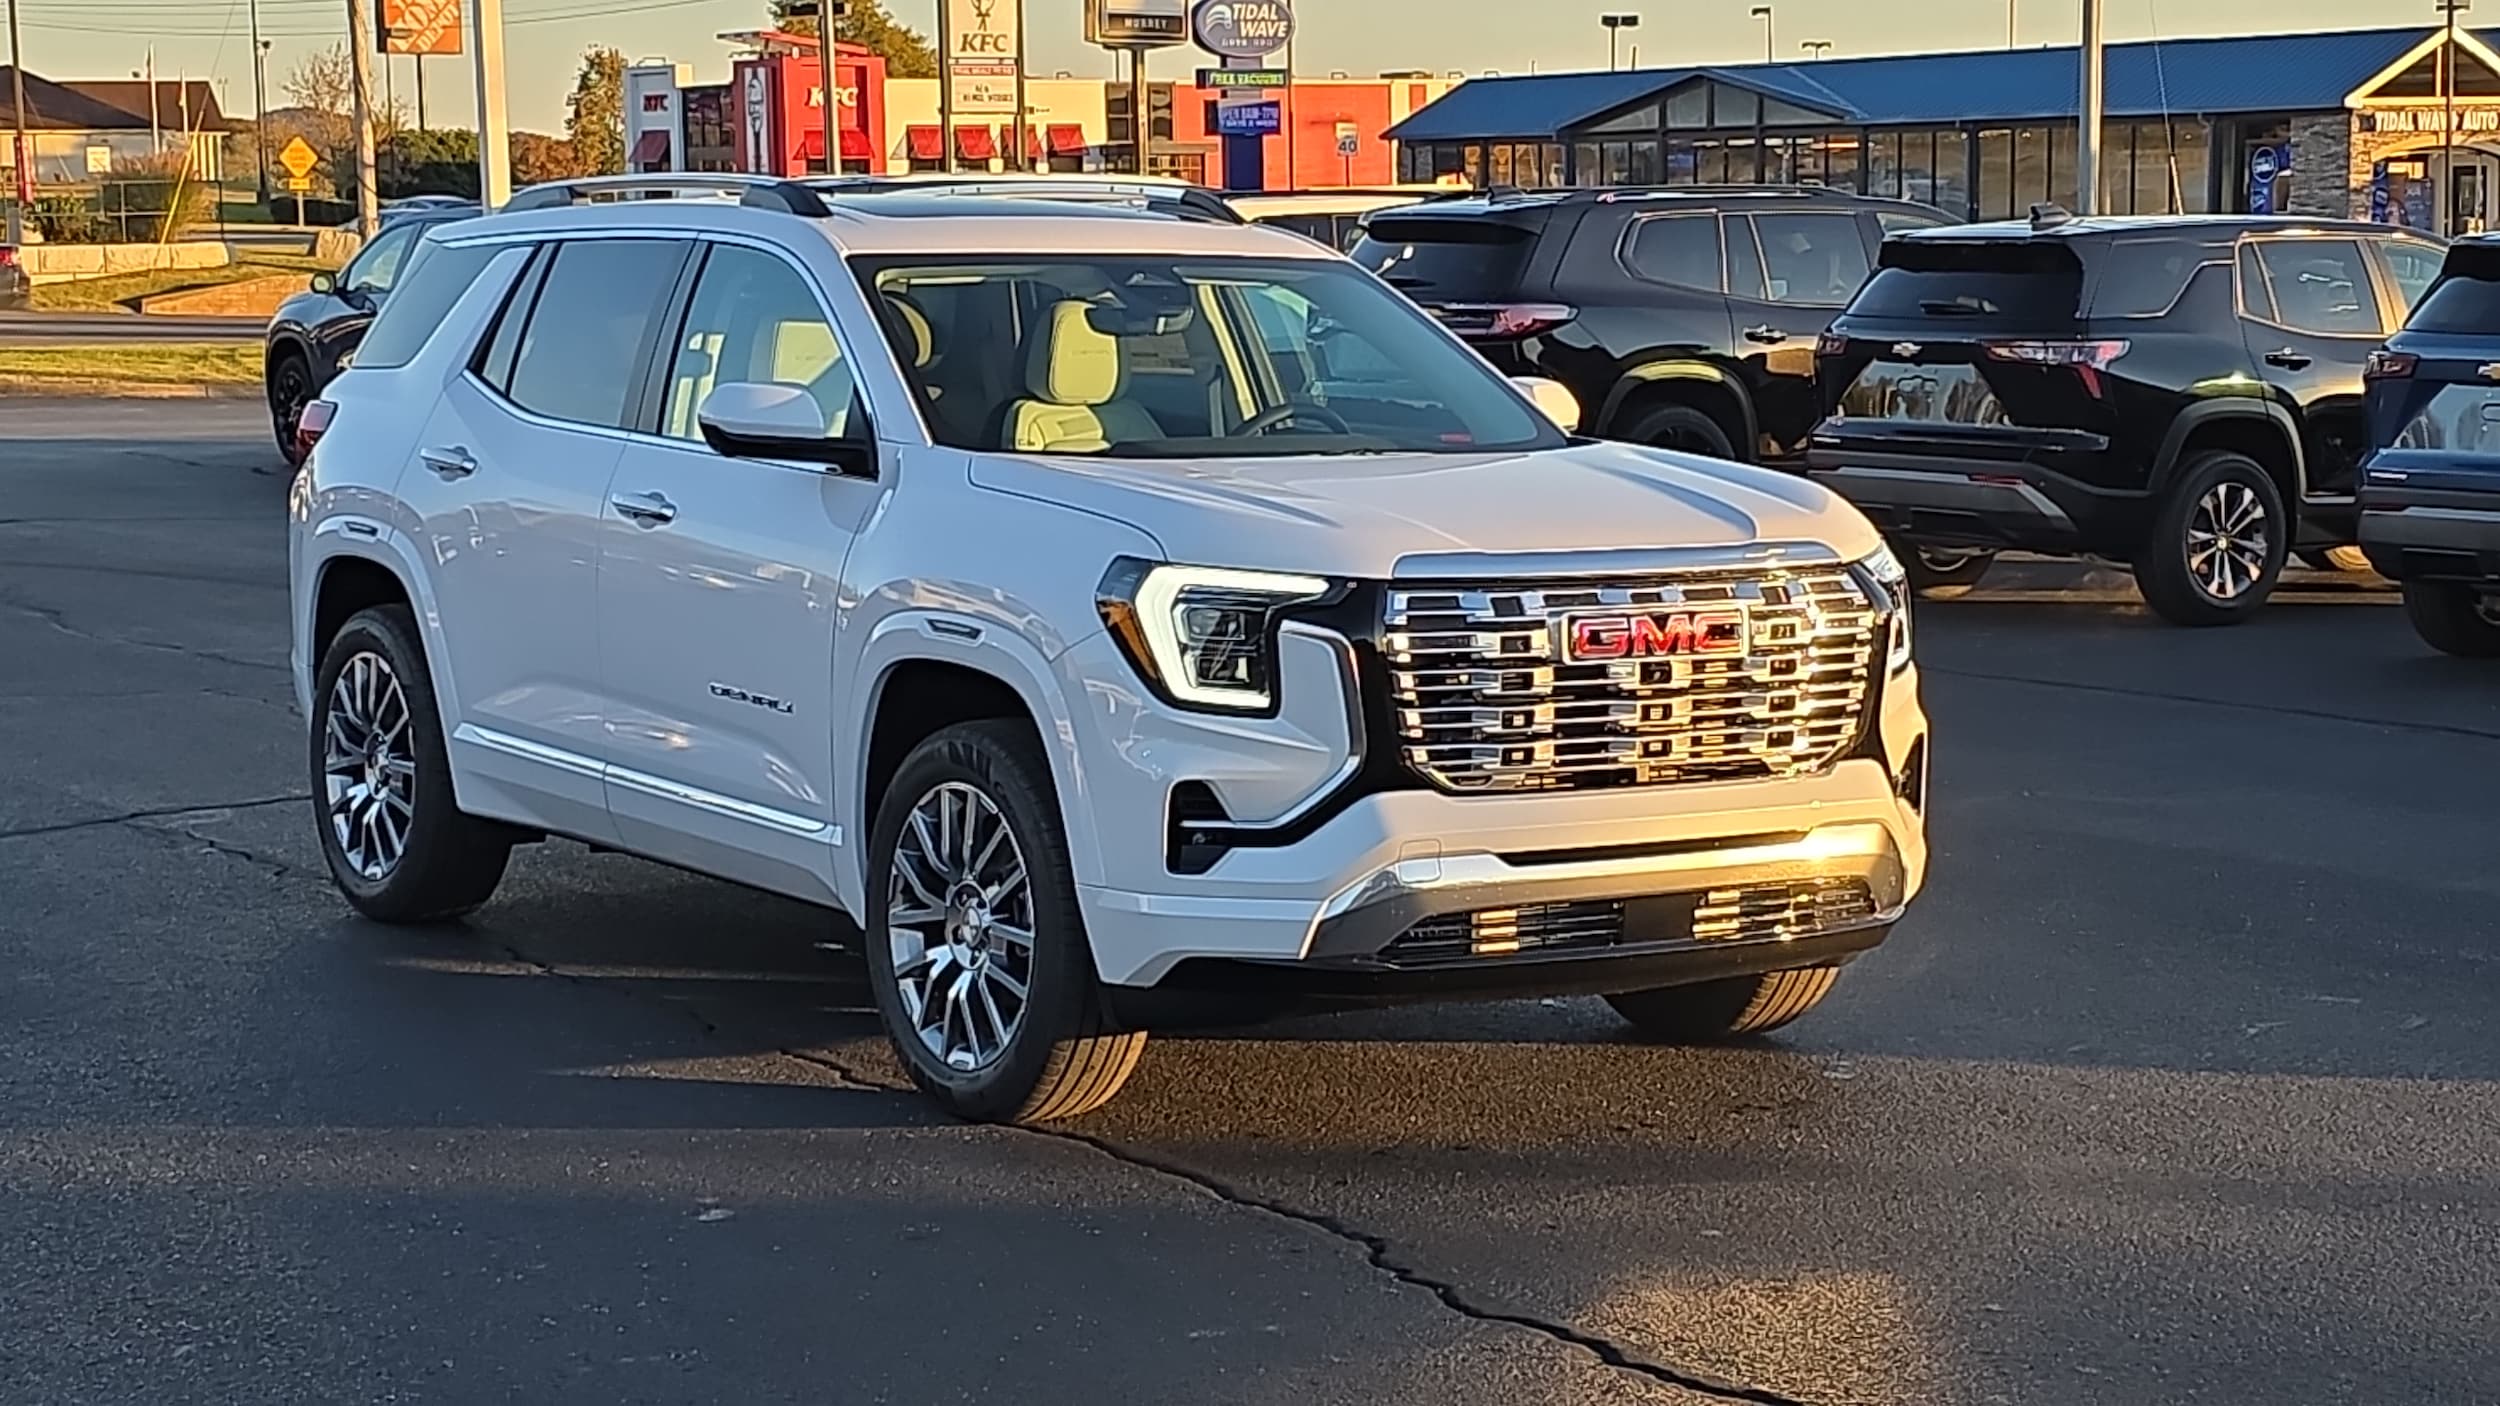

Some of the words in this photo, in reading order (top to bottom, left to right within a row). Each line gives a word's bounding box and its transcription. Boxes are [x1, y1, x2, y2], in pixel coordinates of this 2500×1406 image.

[1232, 3, 1279, 20] TIDAL
[416, 4, 459, 51] DEPOT
[1240, 20, 1289, 38] WAVE
[959, 33, 1008, 53] KFC
[1210, 72, 1236, 85] FREE
[643, 94, 669, 112] KFC
[808, 87, 858, 108] KFC
[2374, 111, 2415, 132] TIDAL
[2462, 111, 2498, 132] AUTO
[1338, 140, 1358, 153] 40
[1574, 613, 1743, 659] GMC
[708, 683, 794, 715] DENALI
